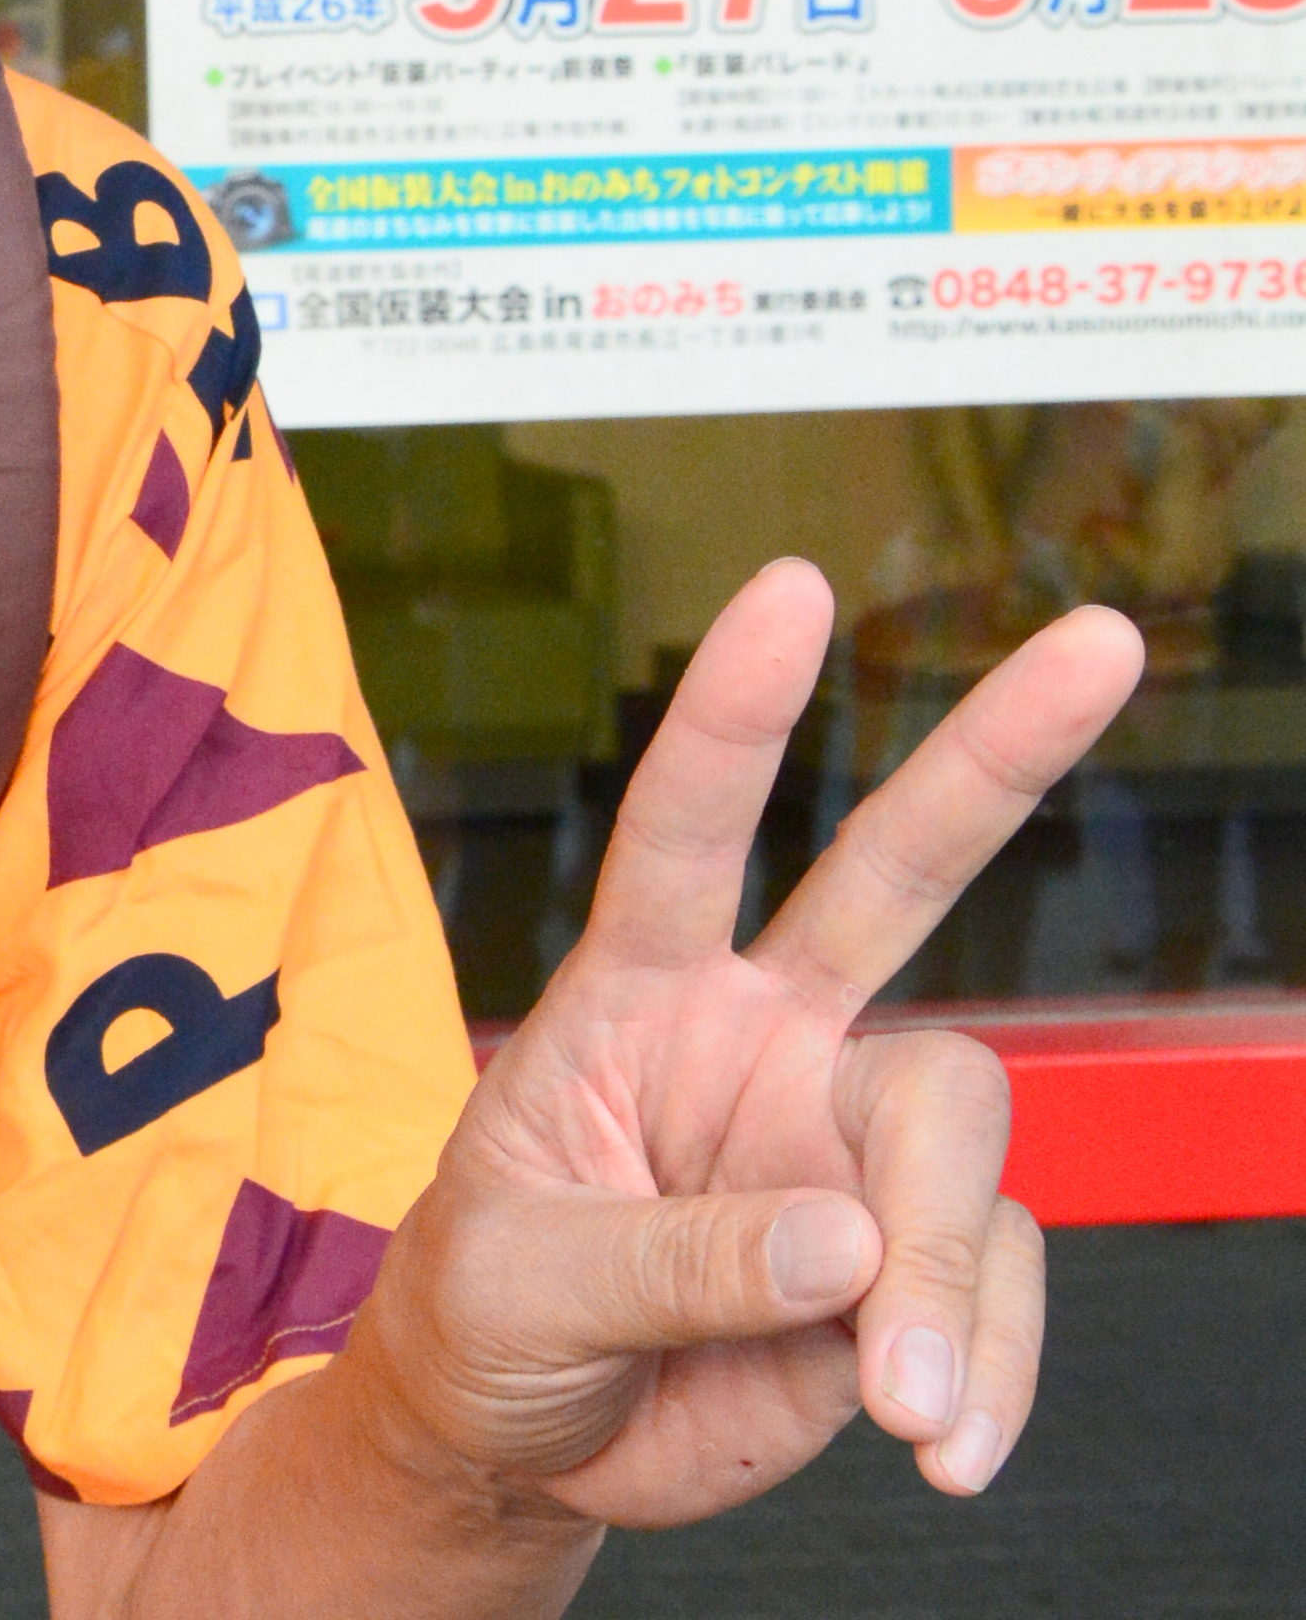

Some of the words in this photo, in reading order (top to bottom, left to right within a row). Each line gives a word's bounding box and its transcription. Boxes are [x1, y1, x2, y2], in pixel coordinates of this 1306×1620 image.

[297, 284, 532, 330] 全国仮装大会
[544, 284, 583, 320] in
[591, 279, 744, 321] おのみち
[43, 951, 282, 1157] P
